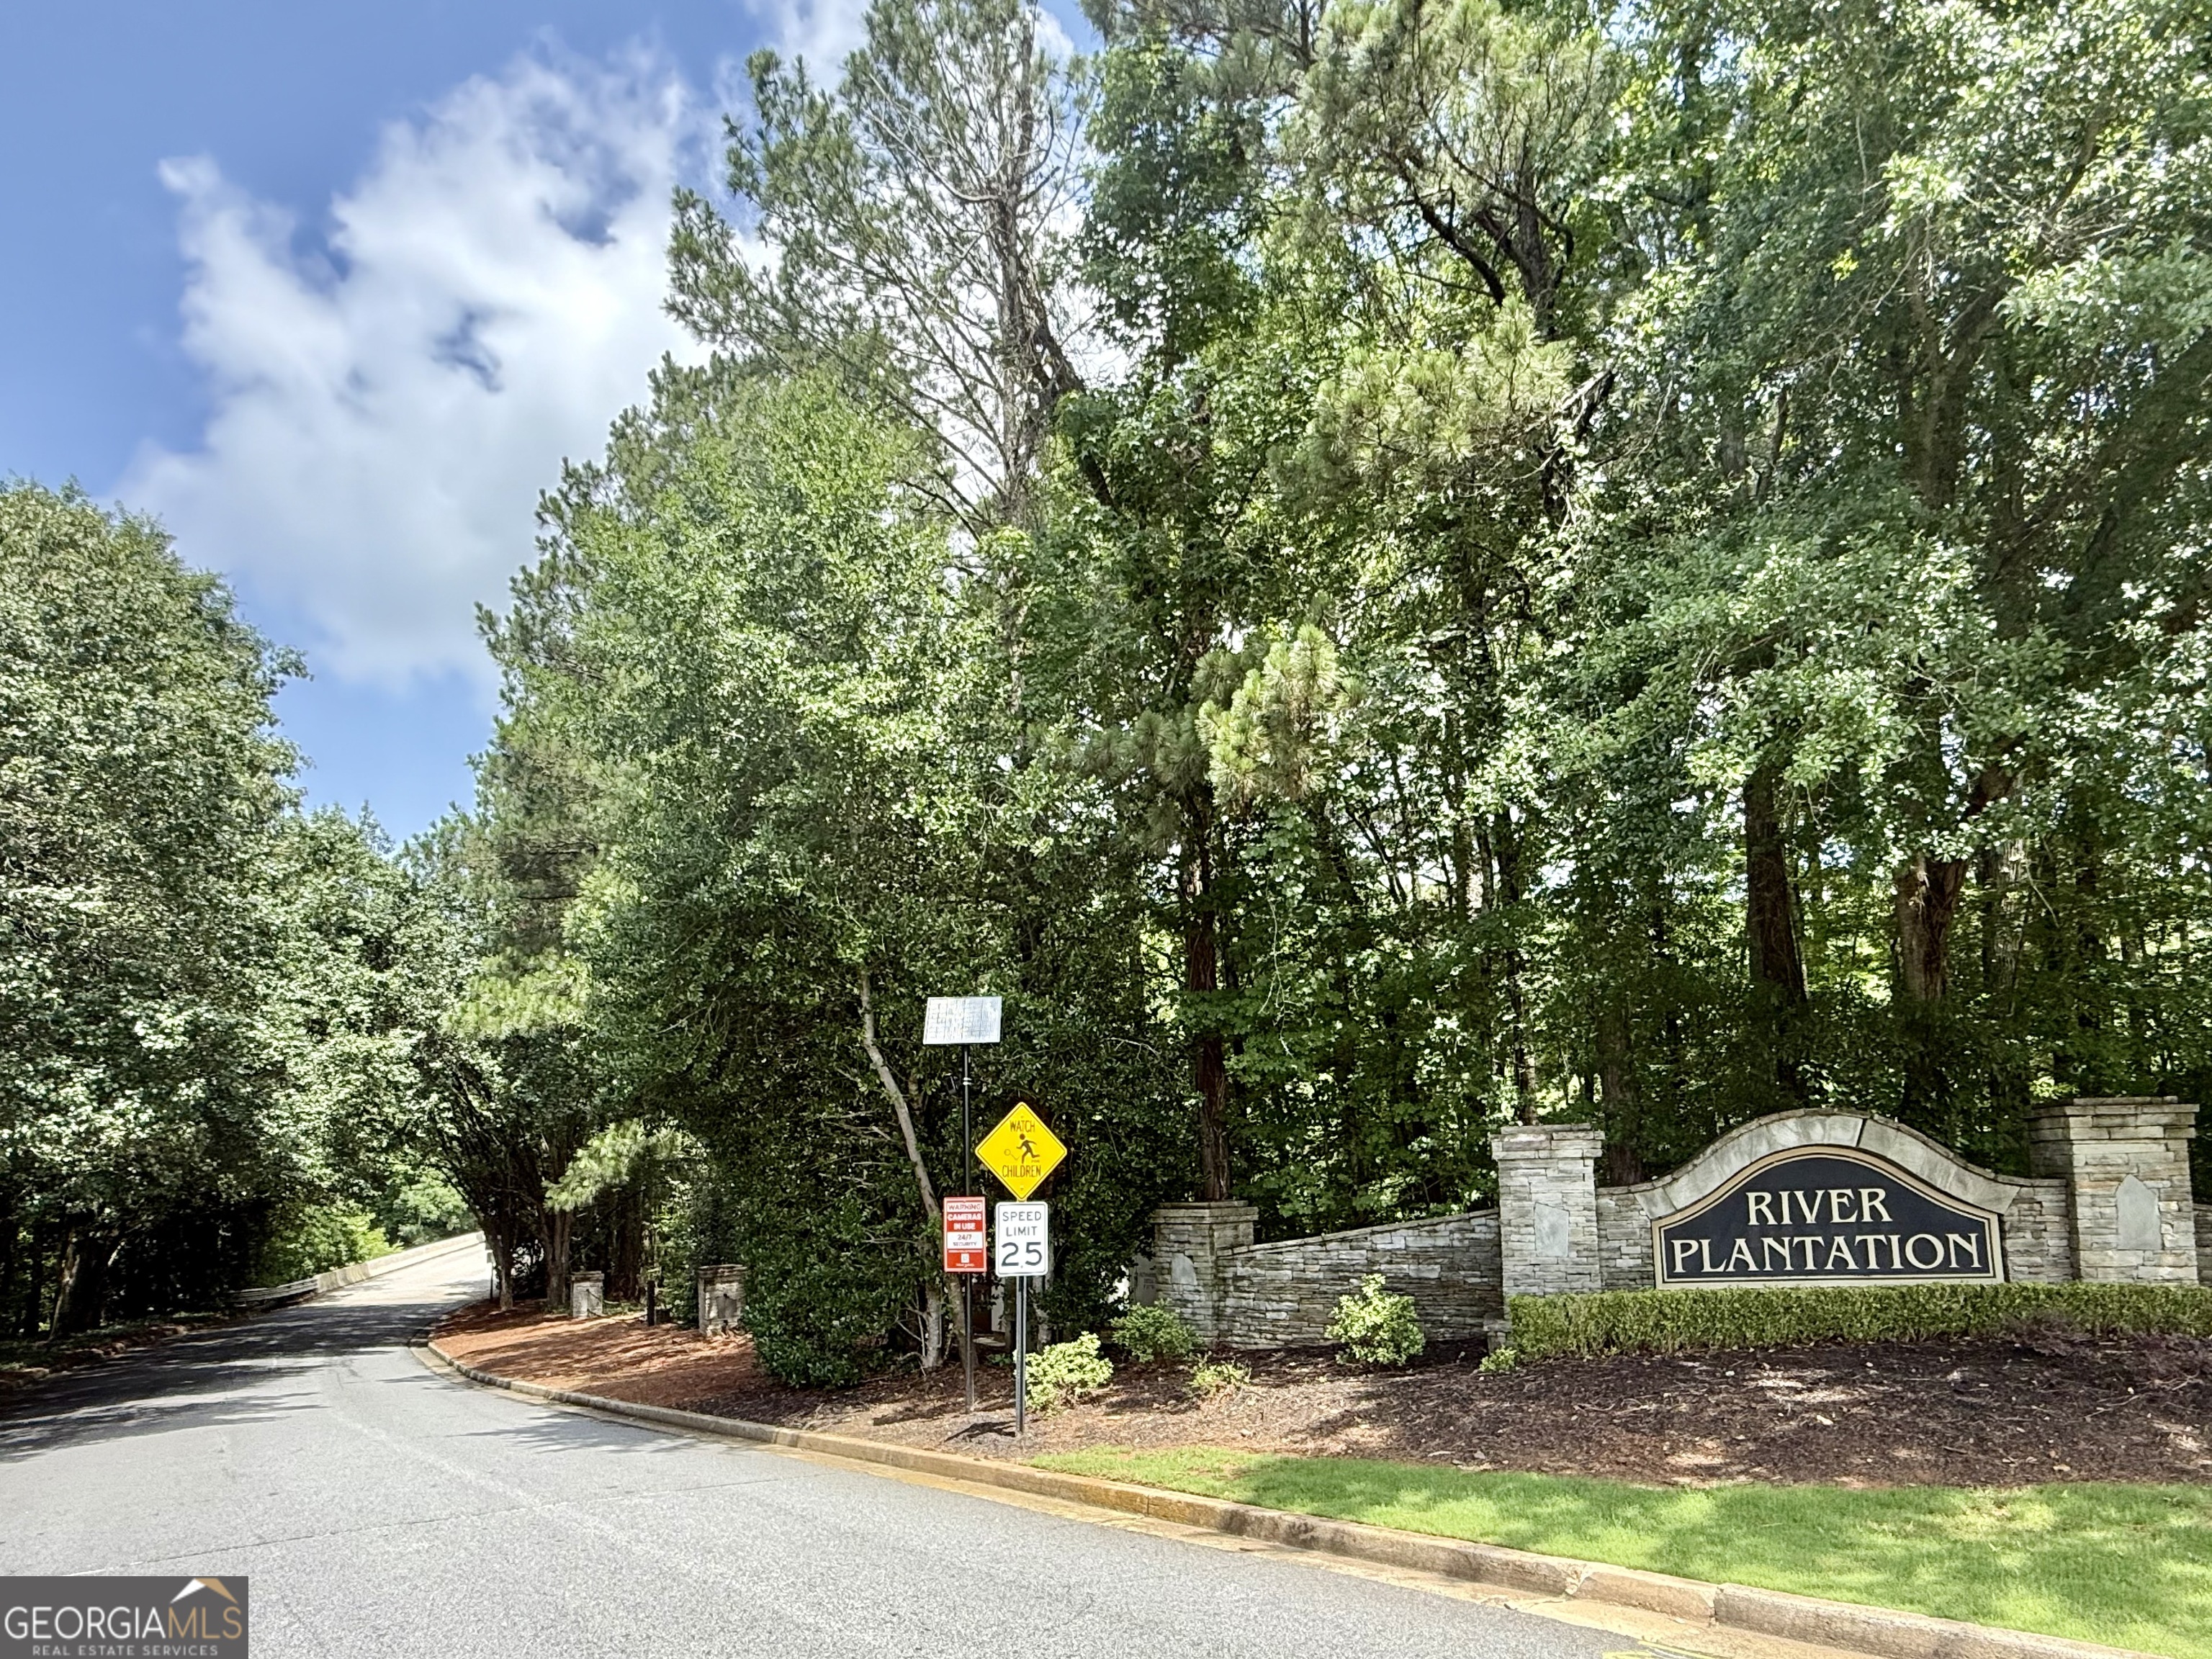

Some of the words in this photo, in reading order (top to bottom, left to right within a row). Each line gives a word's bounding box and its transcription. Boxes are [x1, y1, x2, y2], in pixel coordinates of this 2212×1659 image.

[1010, 1120, 1035, 1133] WATCH
[1002, 1164, 1041, 1178] CHILDREN
[1745, 1188, 1892, 1226] RIVER
[1002, 1211, 1041, 1222] SPEED
[1006, 1226, 1038, 1237] LIMIT
[1002, 1241, 1043, 1267] 25
[1671, 1233, 1982, 1273] PLANTATION
